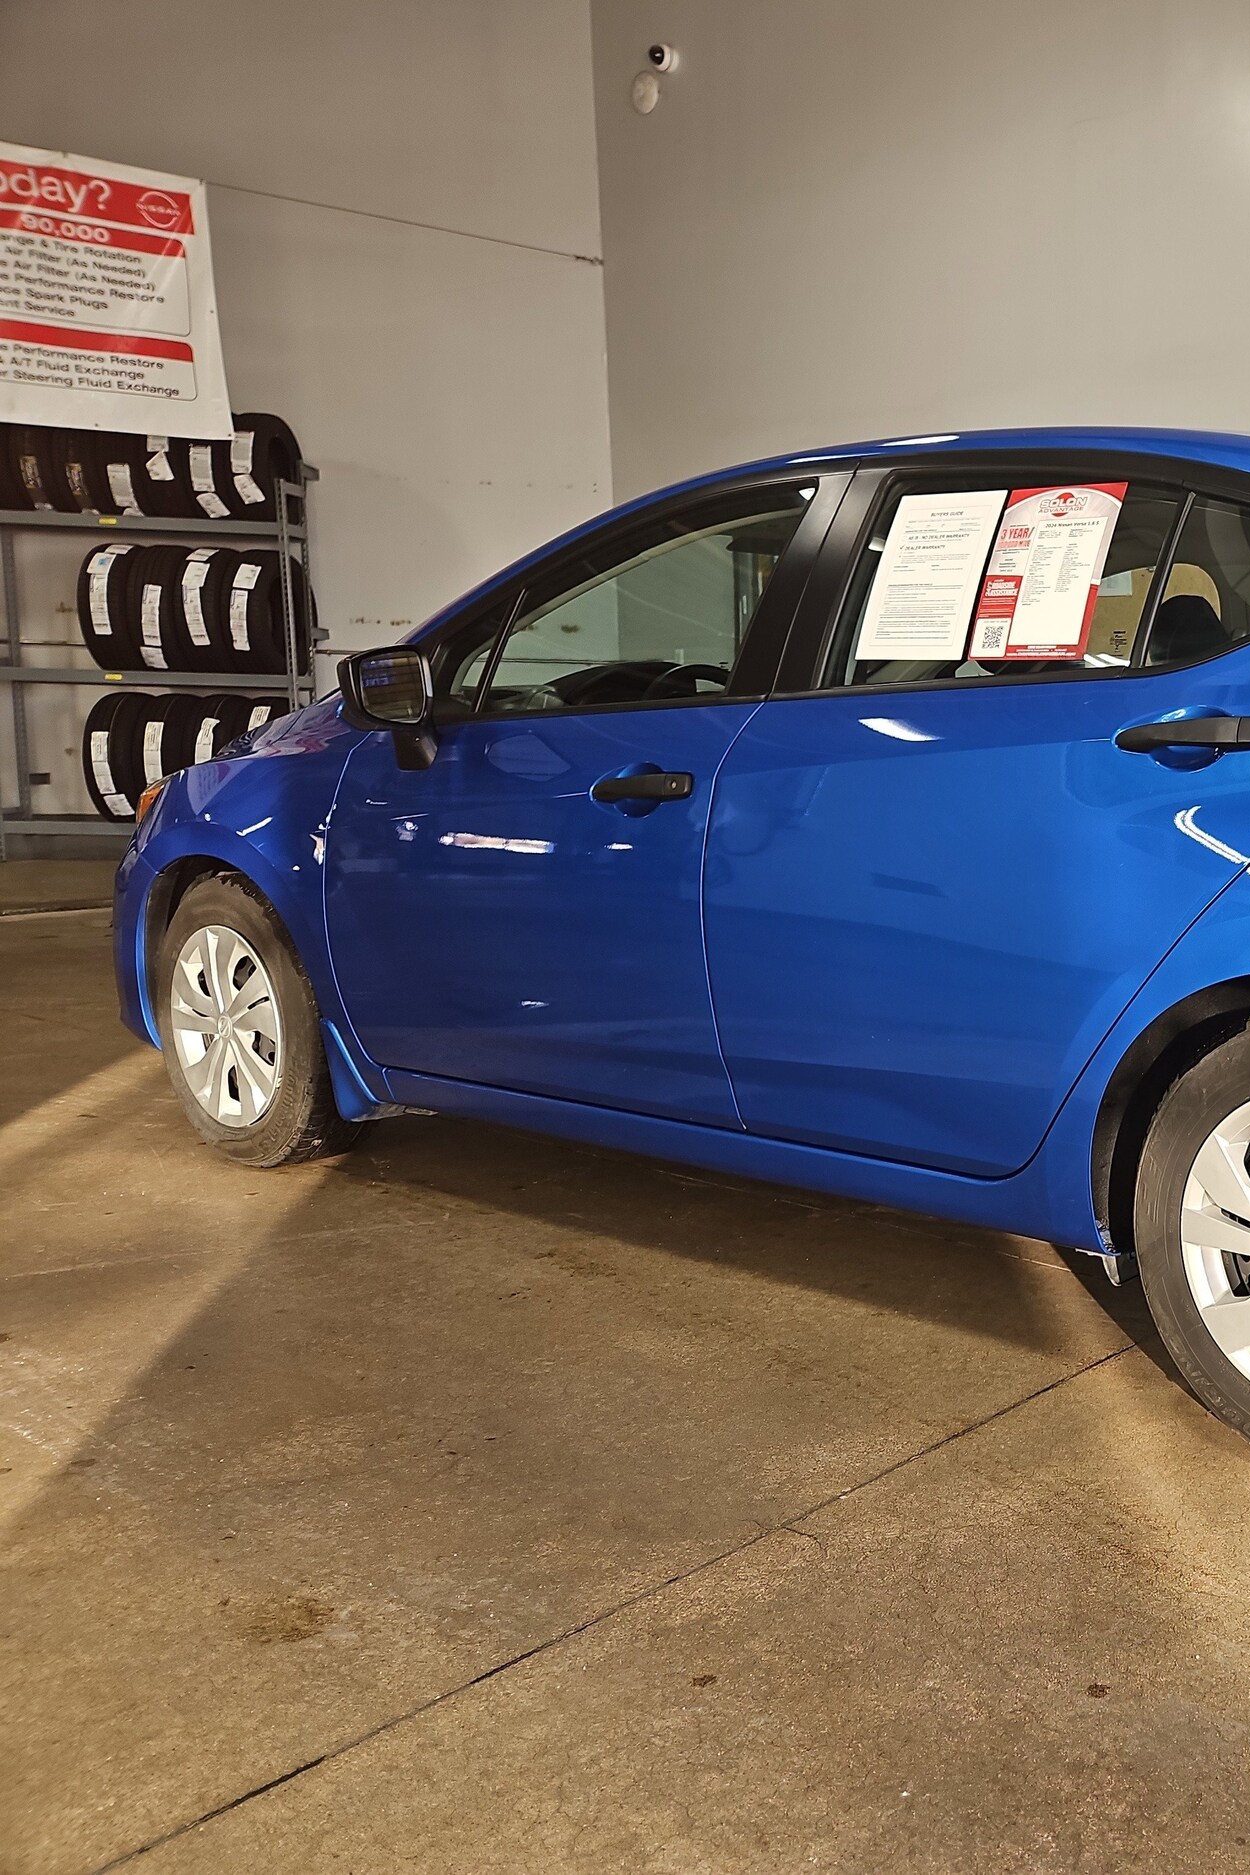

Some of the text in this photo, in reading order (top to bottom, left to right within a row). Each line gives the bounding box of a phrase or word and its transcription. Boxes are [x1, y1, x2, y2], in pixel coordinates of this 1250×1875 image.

[20, 213, 111, 243] 90,000
[5, 246, 22, 255] Air
[28, 249, 61, 263] Filter
[92, 261, 147, 279] Needed)
[54, 240, 79, 254] Tire
[83, 247, 142, 264] Rotation
[13, 260, 31, 271] Air
[37, 263, 70, 277] Filter
[101, 275, 156, 292] Needed)
[14, 272, 105, 296] Performance
[109, 288, 165, 303] Restore
[24, 300, 75, 317] Service
[25, 287, 65, 303] Spark
[69, 295, 109, 310] Plugs
[10, 357, 31, 367] A/T
[36, 359, 70, 372] Fluid
[75, 364, 145, 380] Exchange
[13, 343, 105, 364] Performance
[109, 355, 164, 370] Restore
[13, 369, 74, 387] Steering
[78, 376, 112, 389] Fluid
[117, 381, 180, 397] Exchange
[1038, 506, 1084, 514] ADVANTAGE
[1040, 496, 1088, 508] SOLON
[1000, 529, 1008, 540] 3
[1009, 526, 1035, 540] YEAR/
